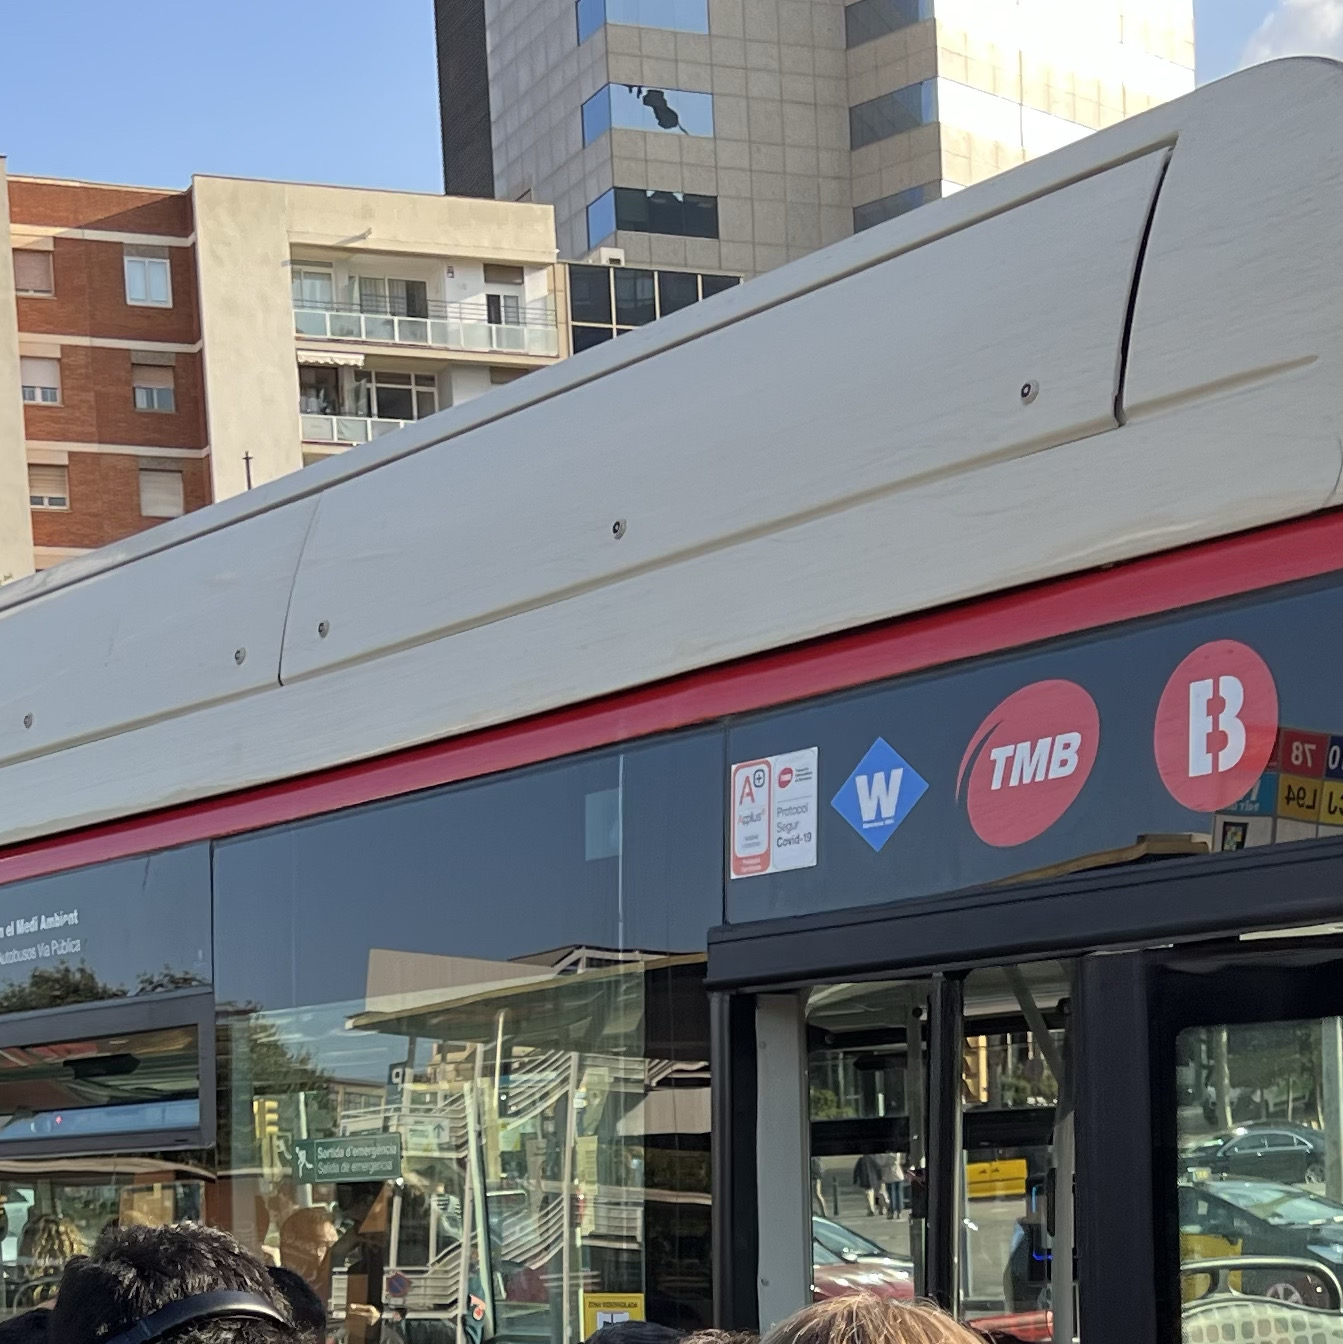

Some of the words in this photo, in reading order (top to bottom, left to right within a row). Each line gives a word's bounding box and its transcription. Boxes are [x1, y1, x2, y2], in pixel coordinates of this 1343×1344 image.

[1188, 675, 1246, 776] B
[990, 731, 1082, 791] TMB
[856, 768, 904, 820] W
[776, 821, 800, 834] Segur
[776, 832, 813, 848] Covid-19
[6, 920, 15, 937] el
[16, 916, 39, 935] Medi
[40, 909, 79, 930] Ambient
